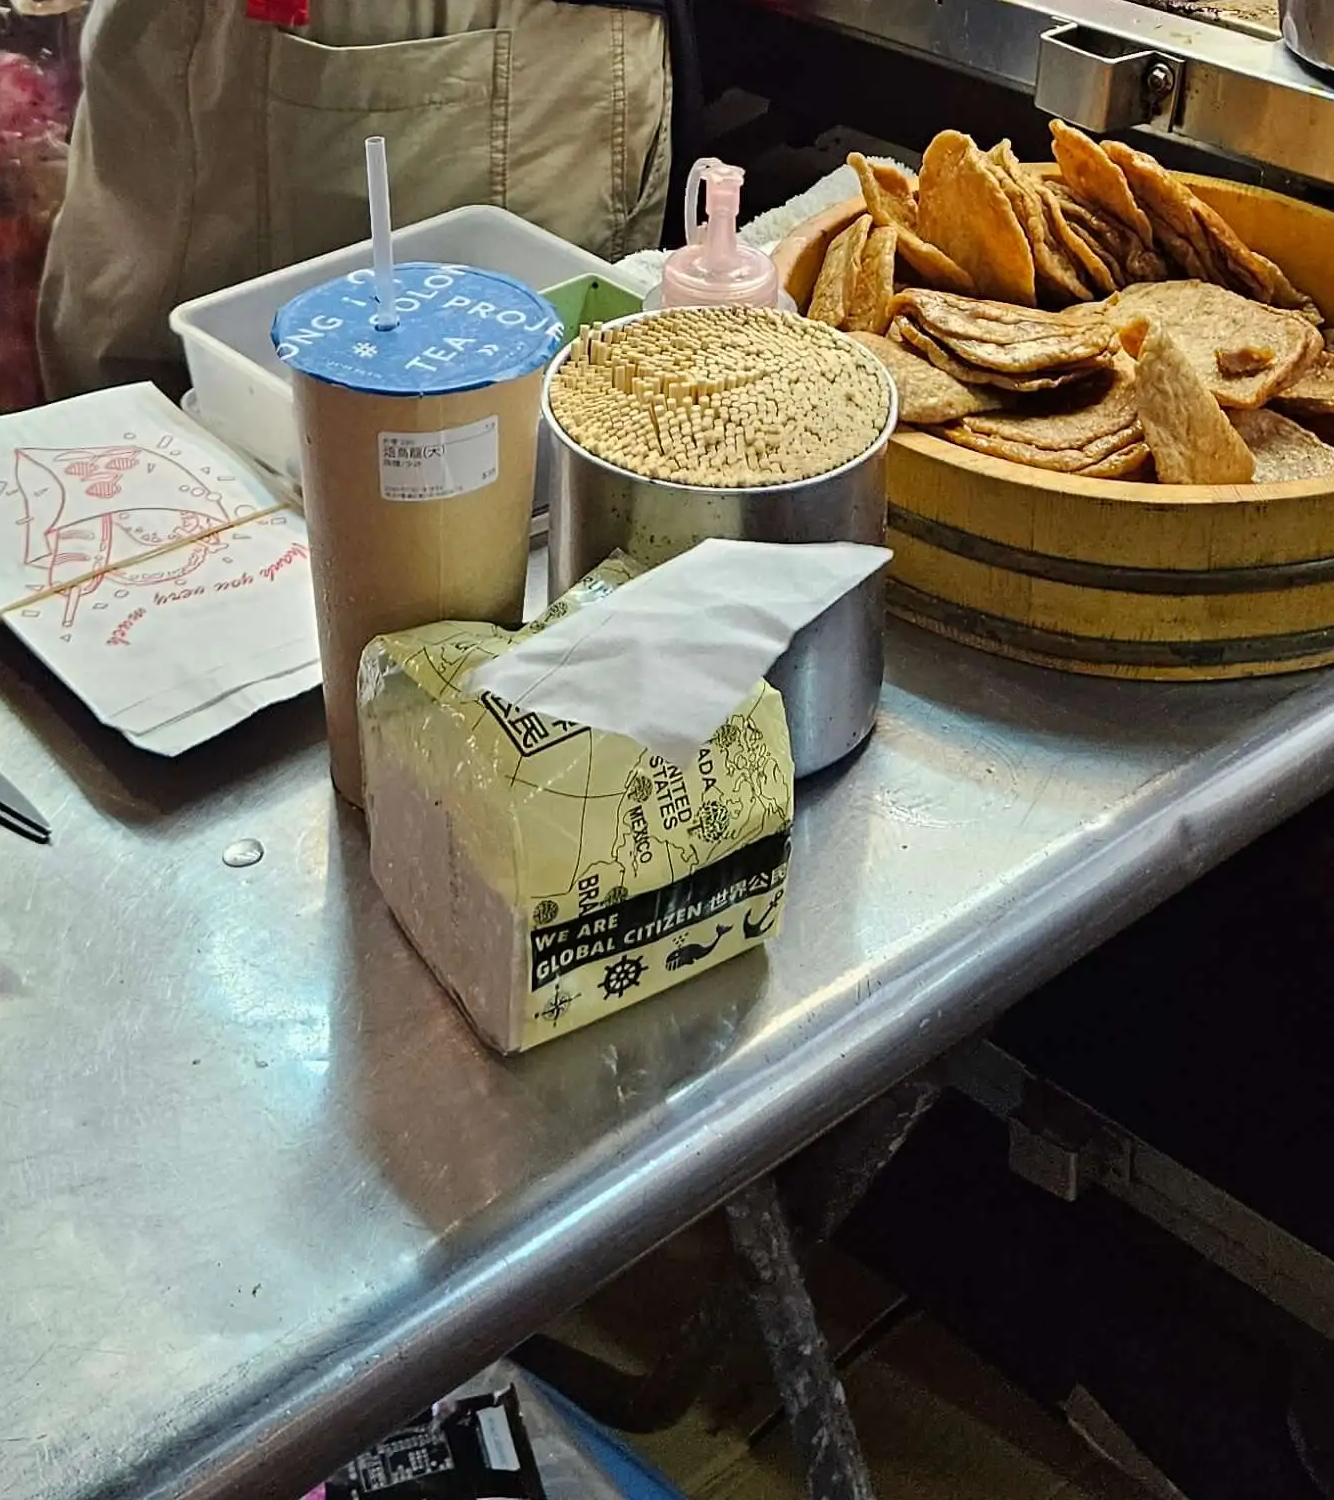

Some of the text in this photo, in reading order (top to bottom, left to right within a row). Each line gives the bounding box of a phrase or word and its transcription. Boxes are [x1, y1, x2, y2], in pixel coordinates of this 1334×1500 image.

[404, 336, 478, 373] TEA
[213, 572, 254, 593] you
[105, 607, 147, 647] much
[699, 748, 718, 792] ADA
[649, 755, 679, 831] STATES
[628, 805, 653, 865] MEXICO
[535, 912, 619, 953] WE ARE
[536, 939, 616, 980] GLOBAL
[623, 901, 704, 945] CITIZEN
